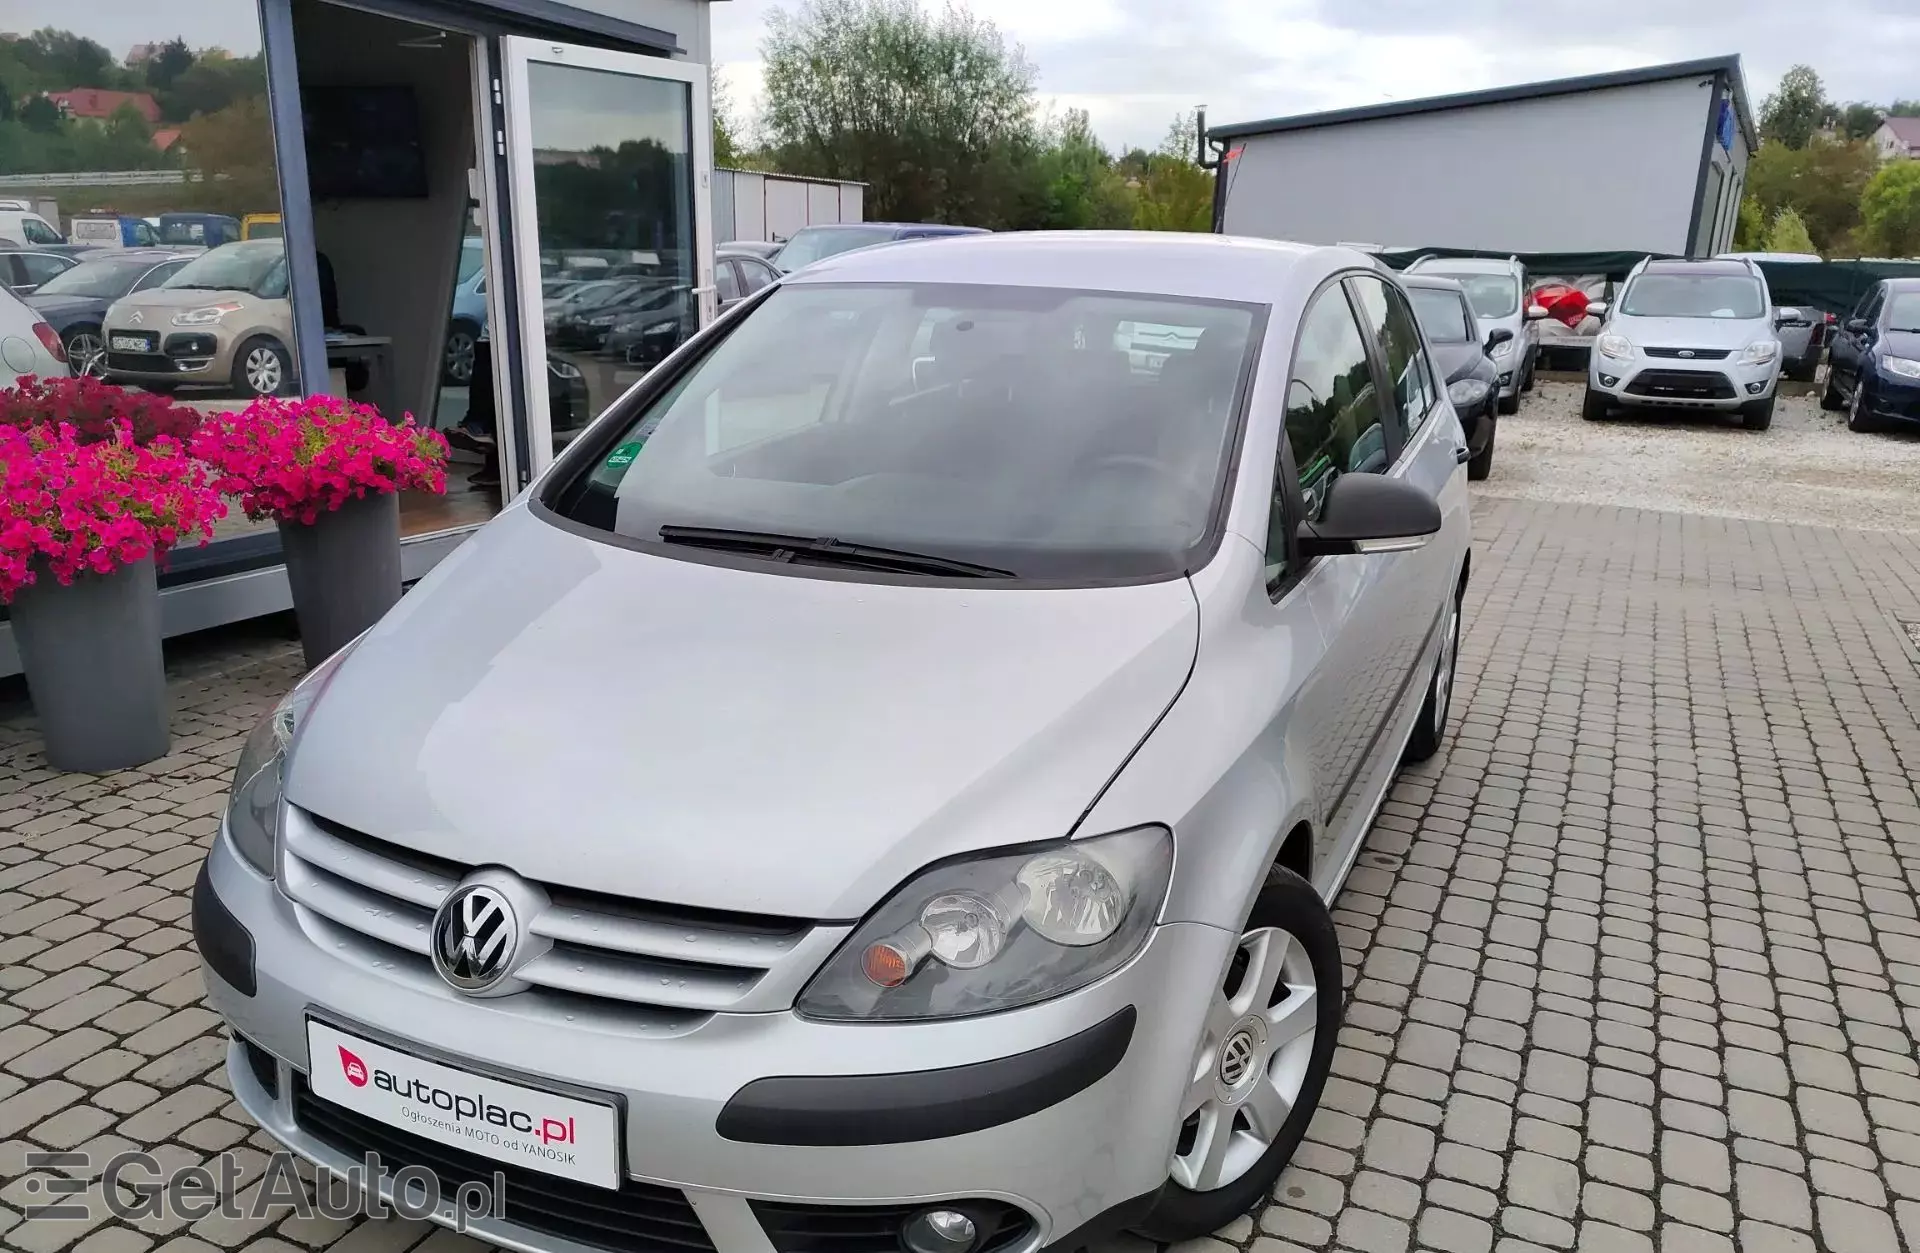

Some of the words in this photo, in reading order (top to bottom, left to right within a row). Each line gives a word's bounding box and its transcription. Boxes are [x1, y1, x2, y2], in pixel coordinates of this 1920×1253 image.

[373, 1068, 576, 1145] autoplac.pl
[401, 1106, 462, 1135] Ogłoszenia
[465, 1126, 500, 1146] MOTO
[503, 1139, 519, 1151] od
[522, 1143, 577, 1165] YANOSIK
